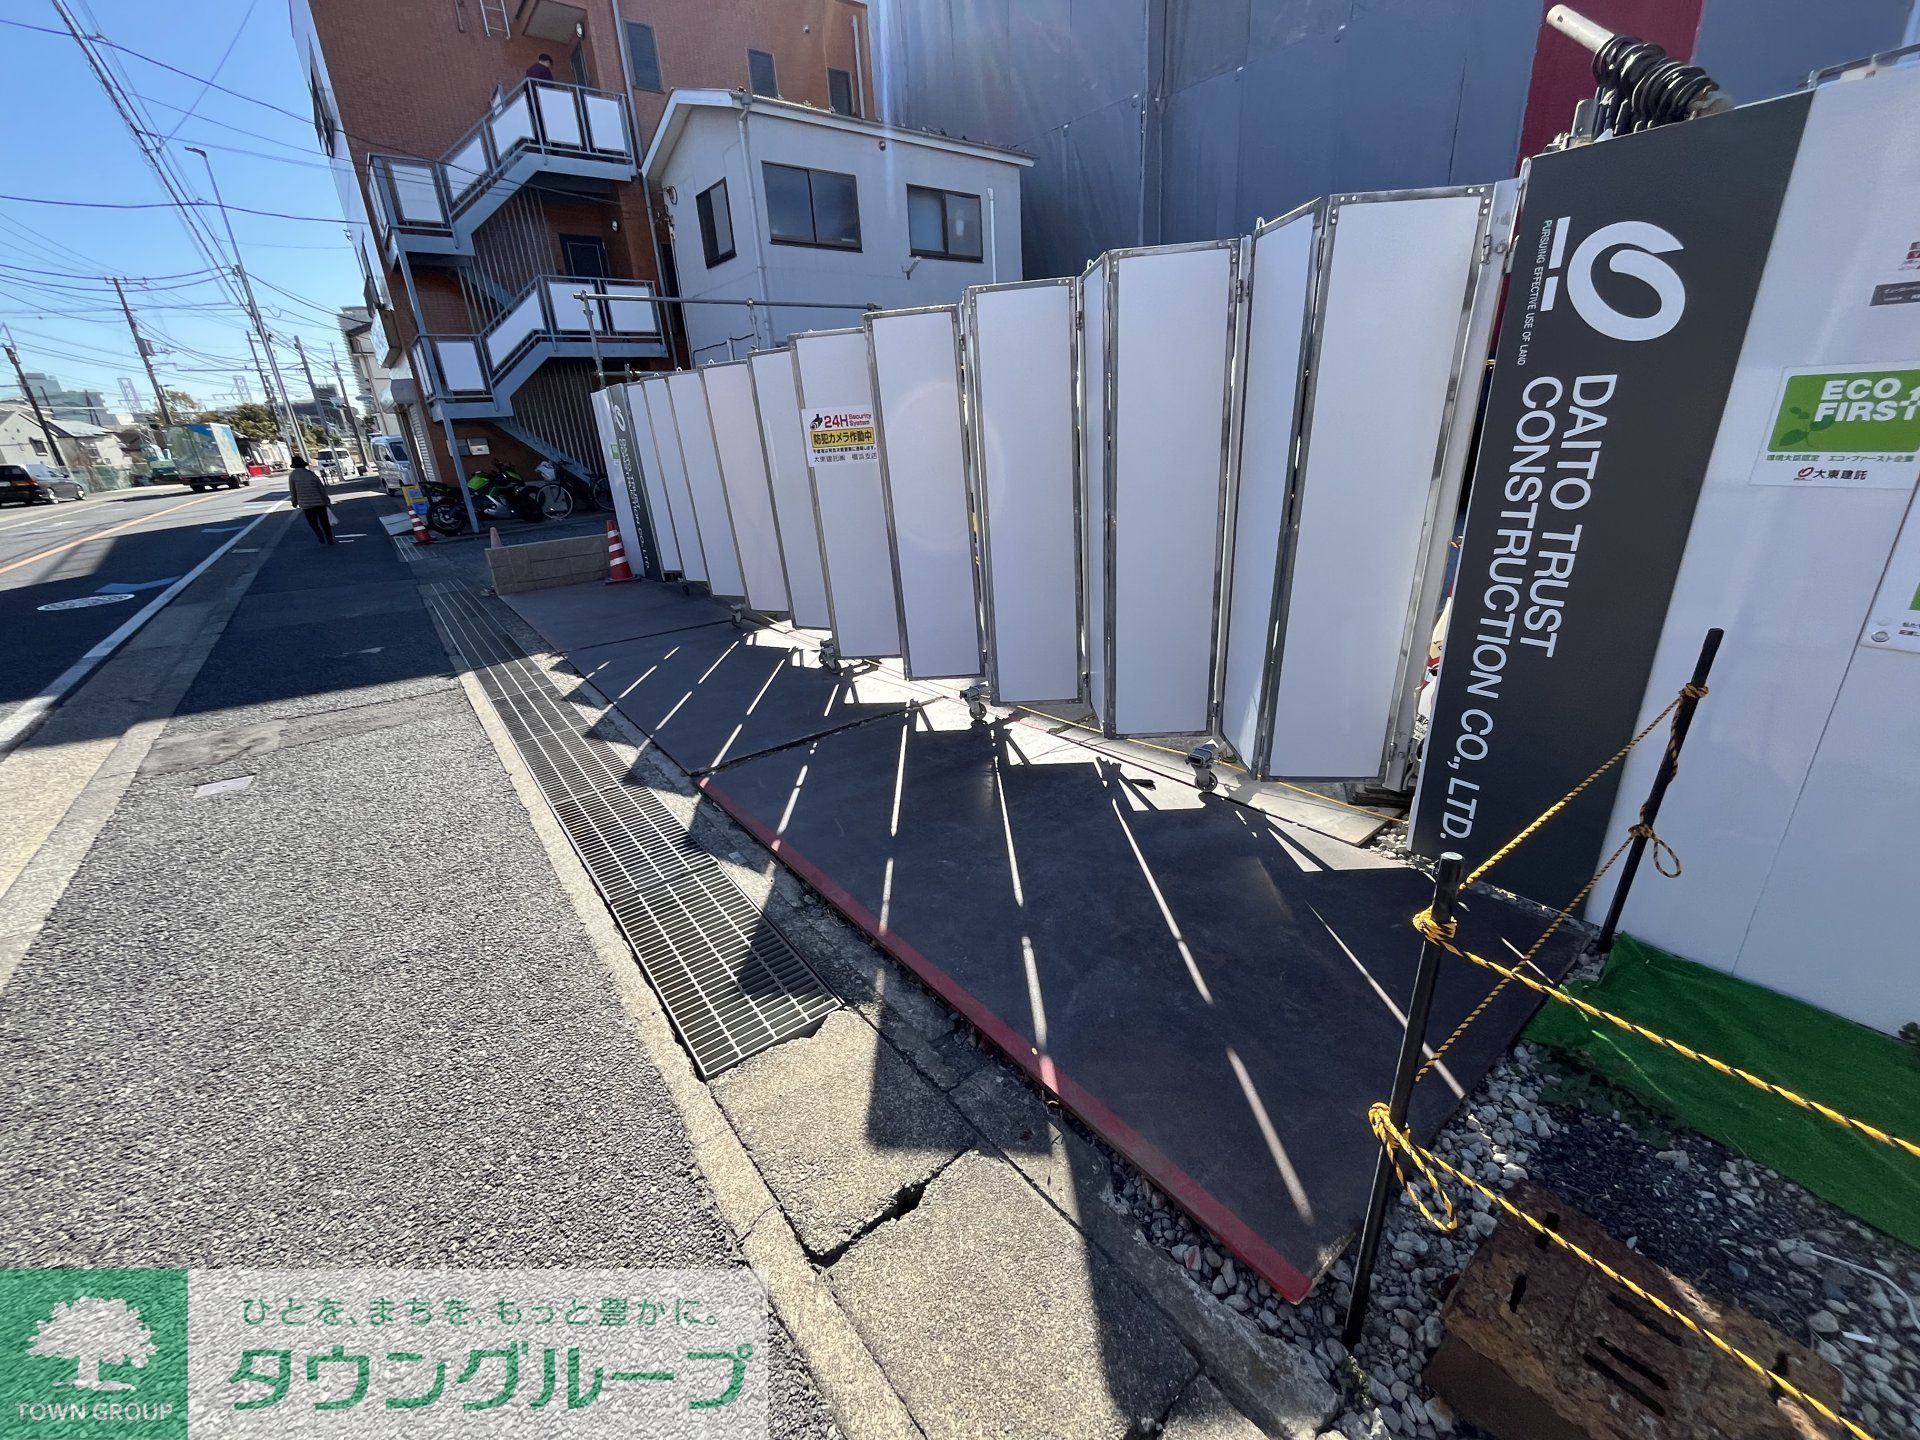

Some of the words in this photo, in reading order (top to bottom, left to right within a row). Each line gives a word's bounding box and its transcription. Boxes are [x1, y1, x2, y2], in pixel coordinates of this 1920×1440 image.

[1536, 219, 1553, 264] PURSUING
[1527, 266, 1544, 310] EFFECTIVE
[1522, 331, 1532, 342] OF
[1523, 312, 1535, 329] USE
[1517, 344, 1529, 366] LAND
[1820, 377, 1902, 401] ECO
[813, 430, 872, 444] 防犯カメラ作動中
[824, 414, 848, 428] 24H
[1549, 374, 1618, 511] DAITO
[1813, 469, 1868, 480] 大東建託
[1467, 376, 1564, 699] CONSTRUCTION
[1519, 524, 1583, 658] TRUST
[1447, 708, 1494, 770] CO.,
[1440, 777, 1480, 840] LTD.
